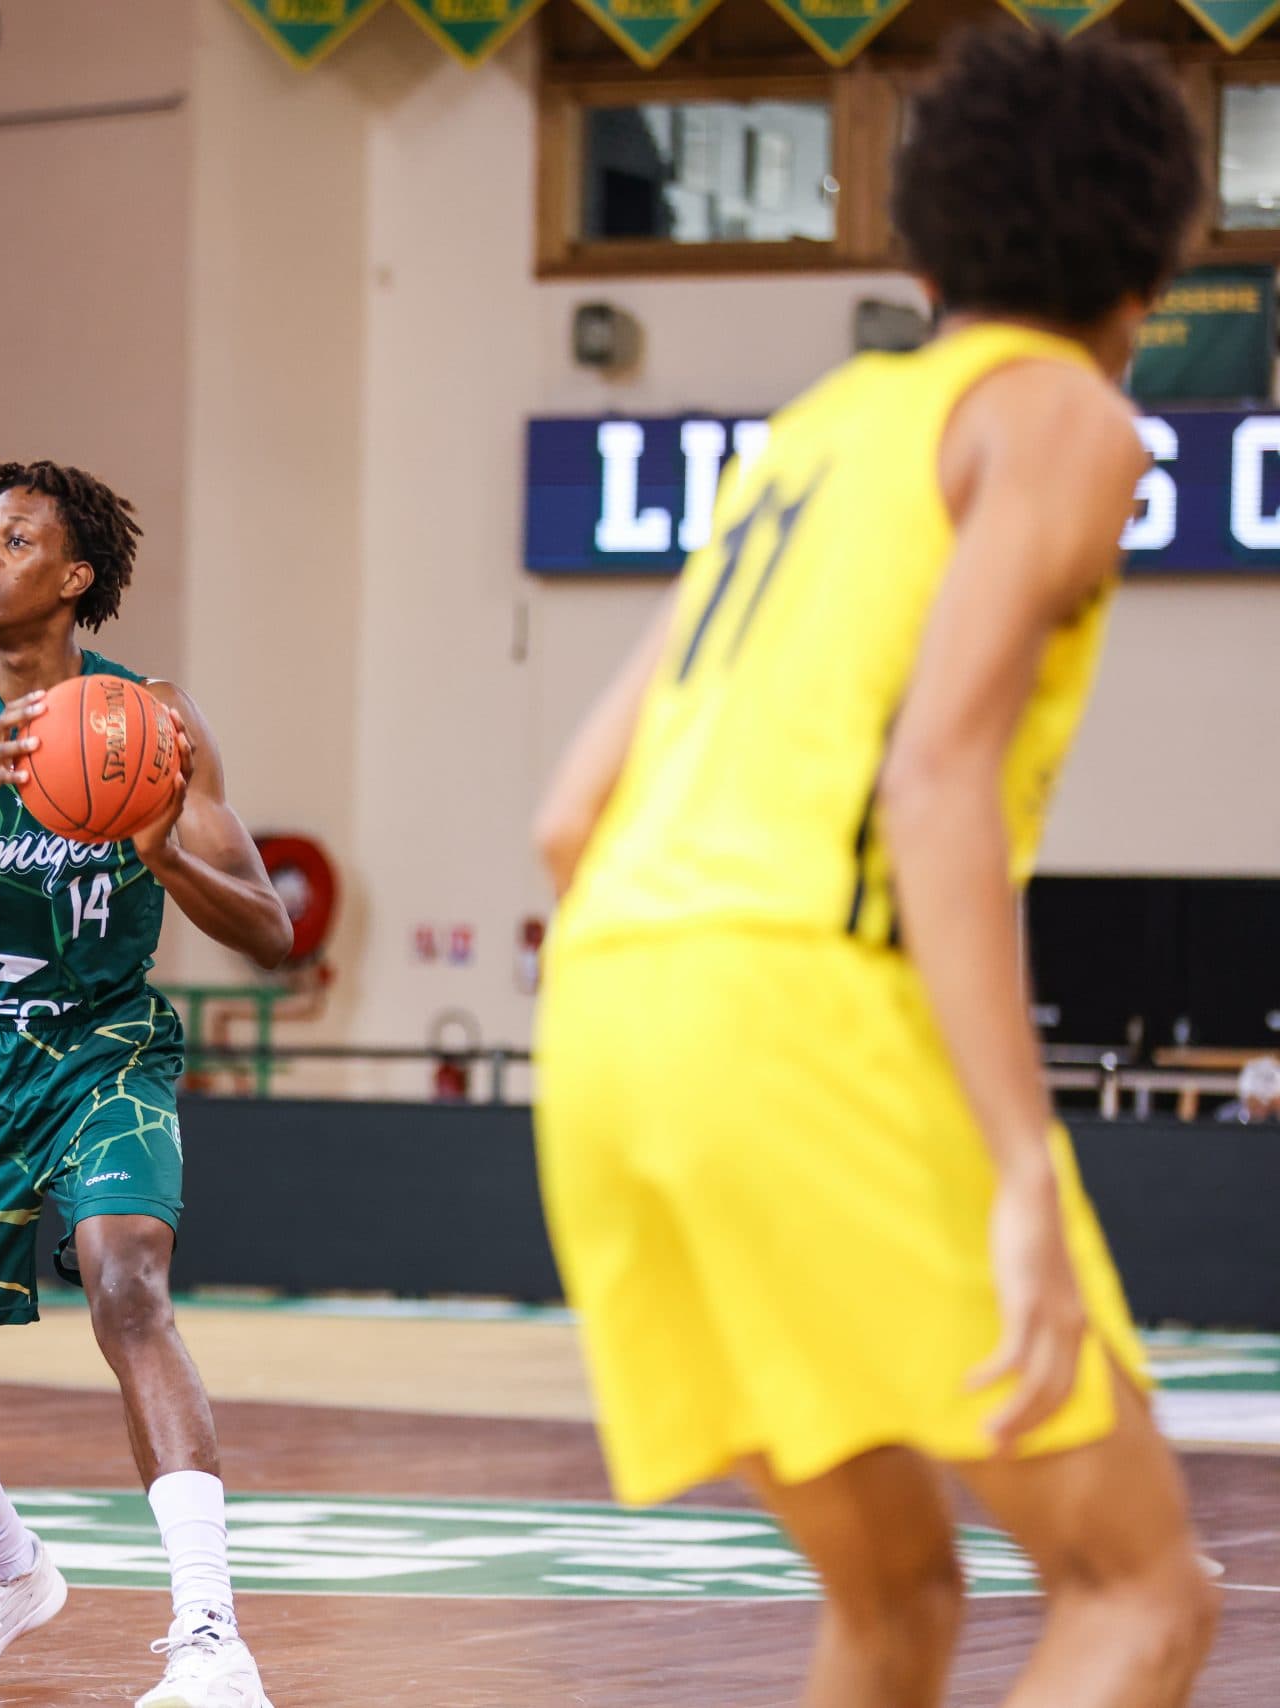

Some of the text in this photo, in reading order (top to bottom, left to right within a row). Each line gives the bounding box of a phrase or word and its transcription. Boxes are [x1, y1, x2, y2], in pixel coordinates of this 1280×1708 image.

[677, 455, 833, 685] 11
[101, 681, 126, 784] SPALDING
[67, 872, 113, 940] 14
[86, 1173, 120, 1186] CRAFT
